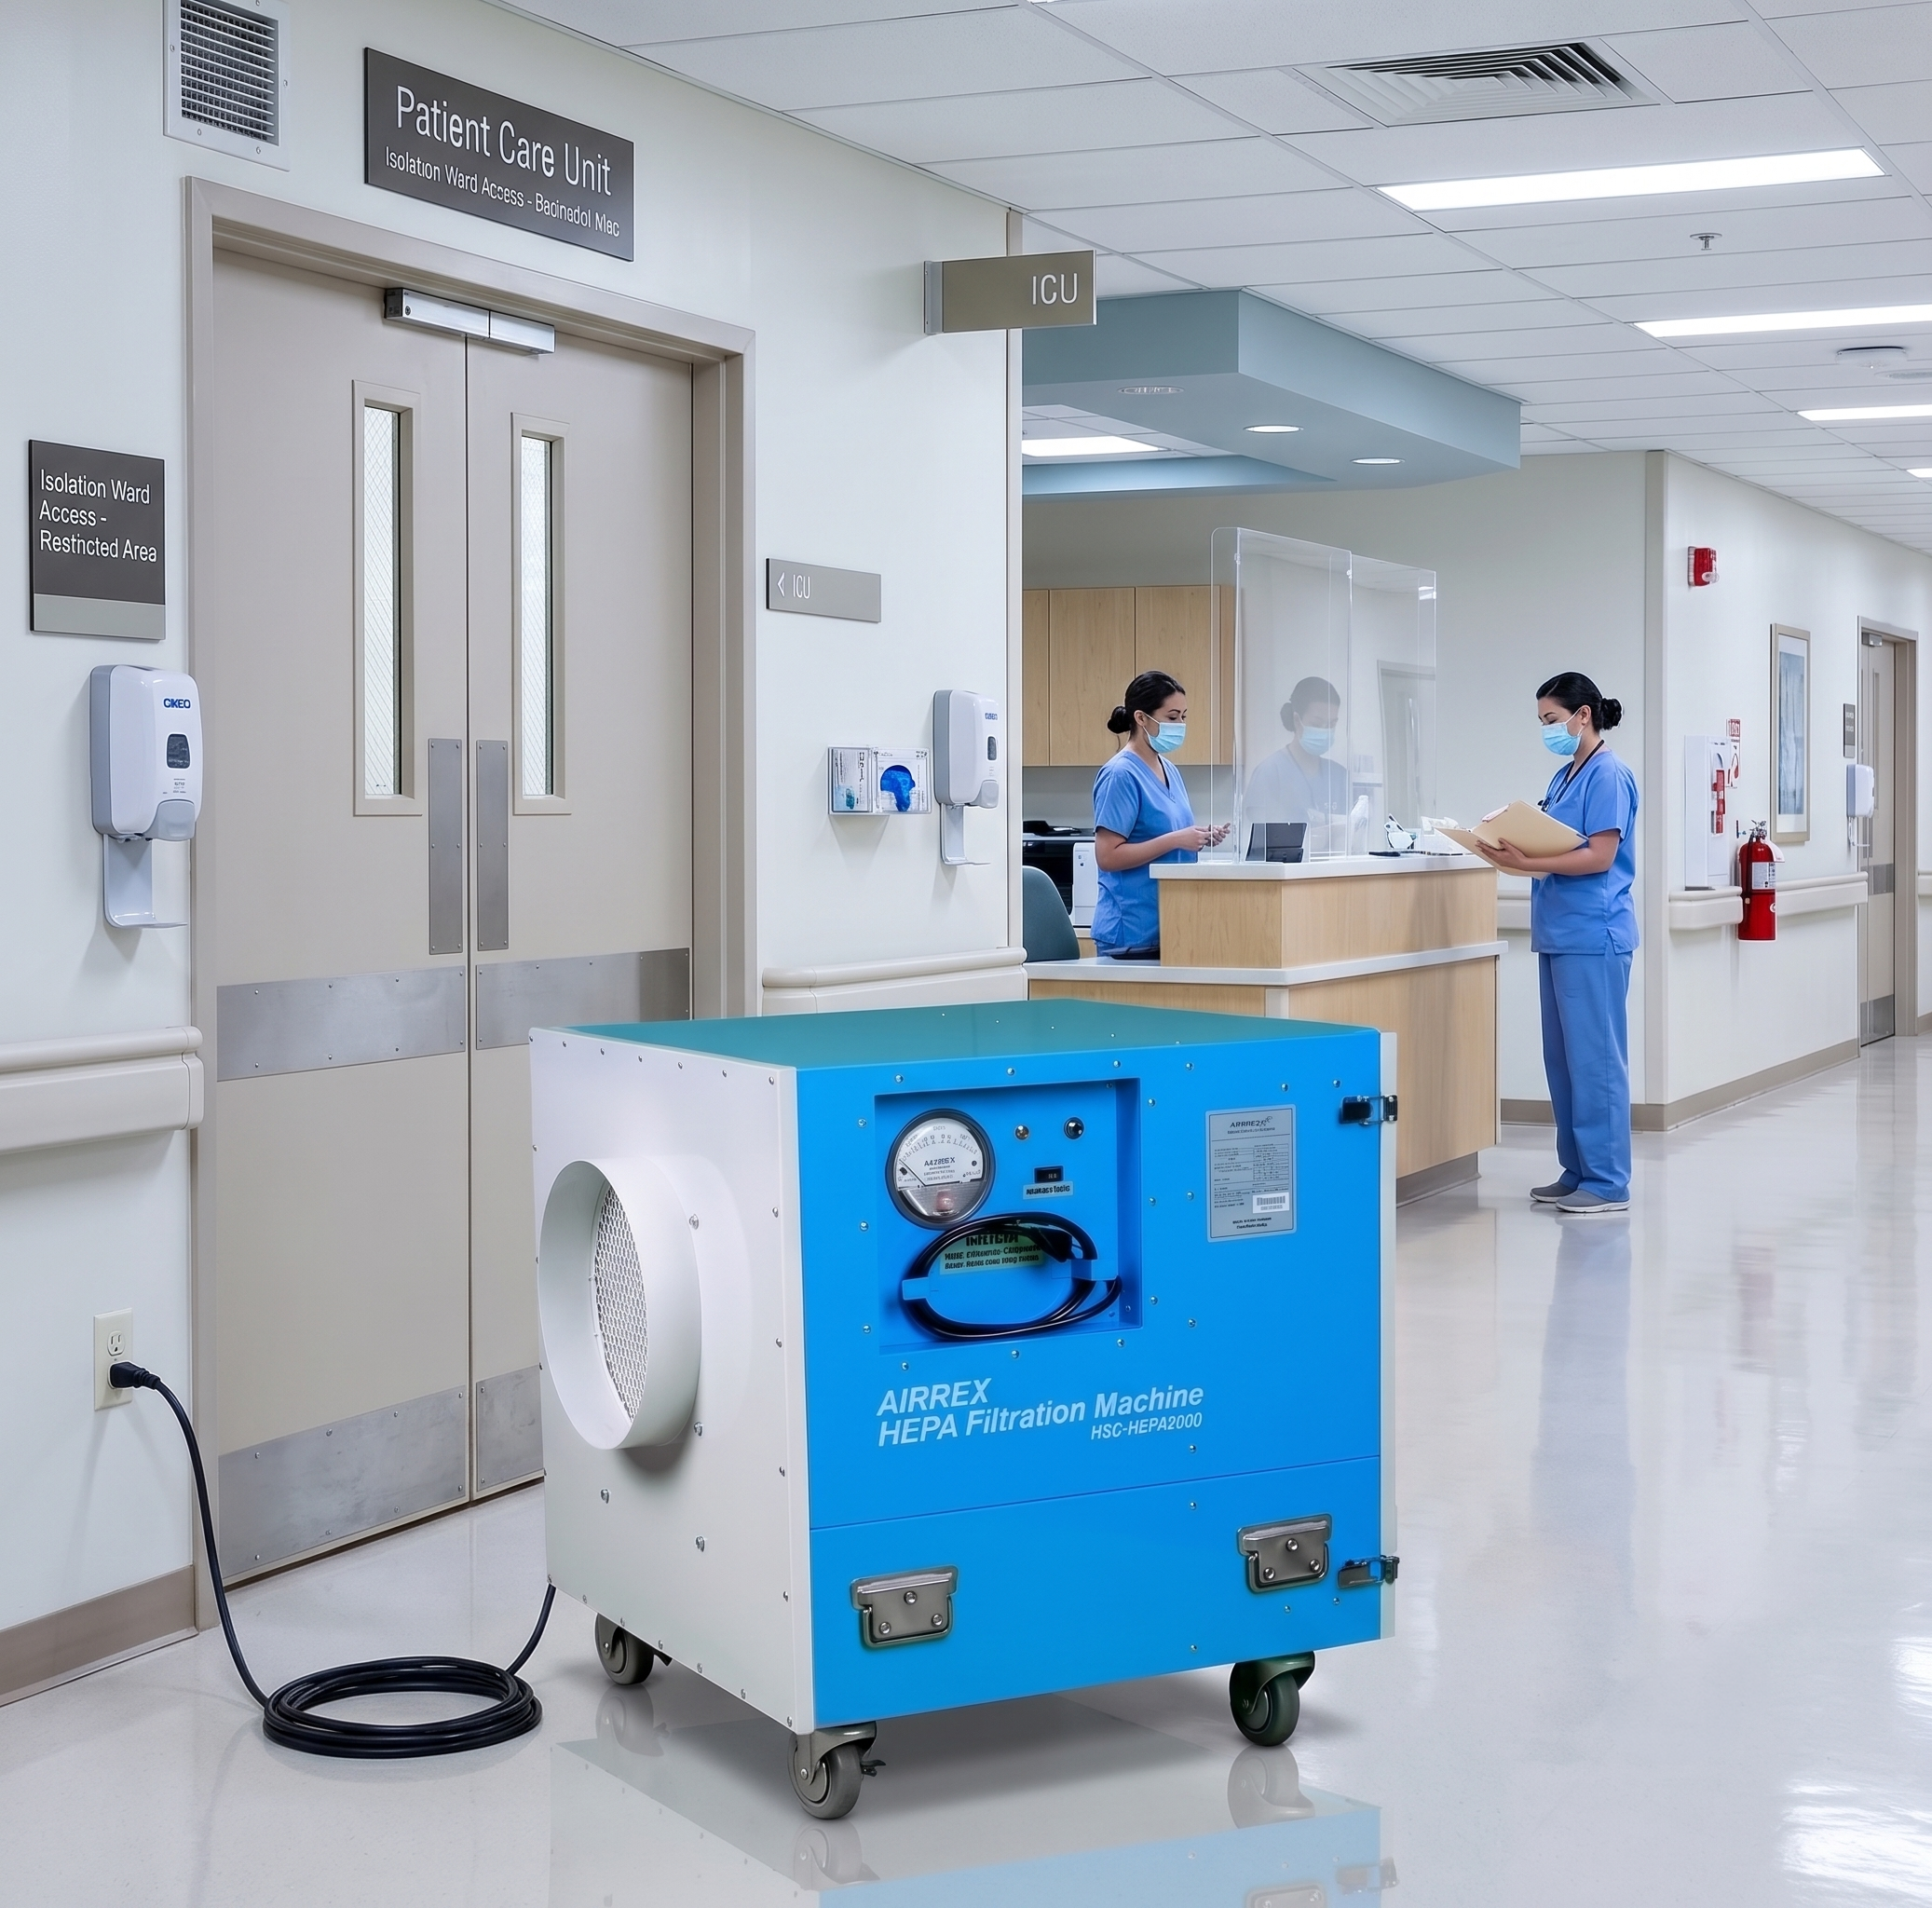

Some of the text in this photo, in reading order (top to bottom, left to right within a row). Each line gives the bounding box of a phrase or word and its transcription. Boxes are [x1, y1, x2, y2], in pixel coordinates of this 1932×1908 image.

[397, 85, 612, 196] Patient Care Unit
[386, 145, 441, 182] Isolation
[444, 164, 478, 194] Ward
[1032, 272, 1078, 305] ICU
[40, 469, 150, 504] Isolation Ward
[39, 499, 97, 526] Access
[122, 538, 157, 563] Area
[793, 574, 810, 599] ICU
[876, 1377, 992, 1416] AIRREX
[878, 1384, 1204, 1447] HEPA Filtration Machine
[1090, 1411, 1203, 1440] HSC-HEPA2000
